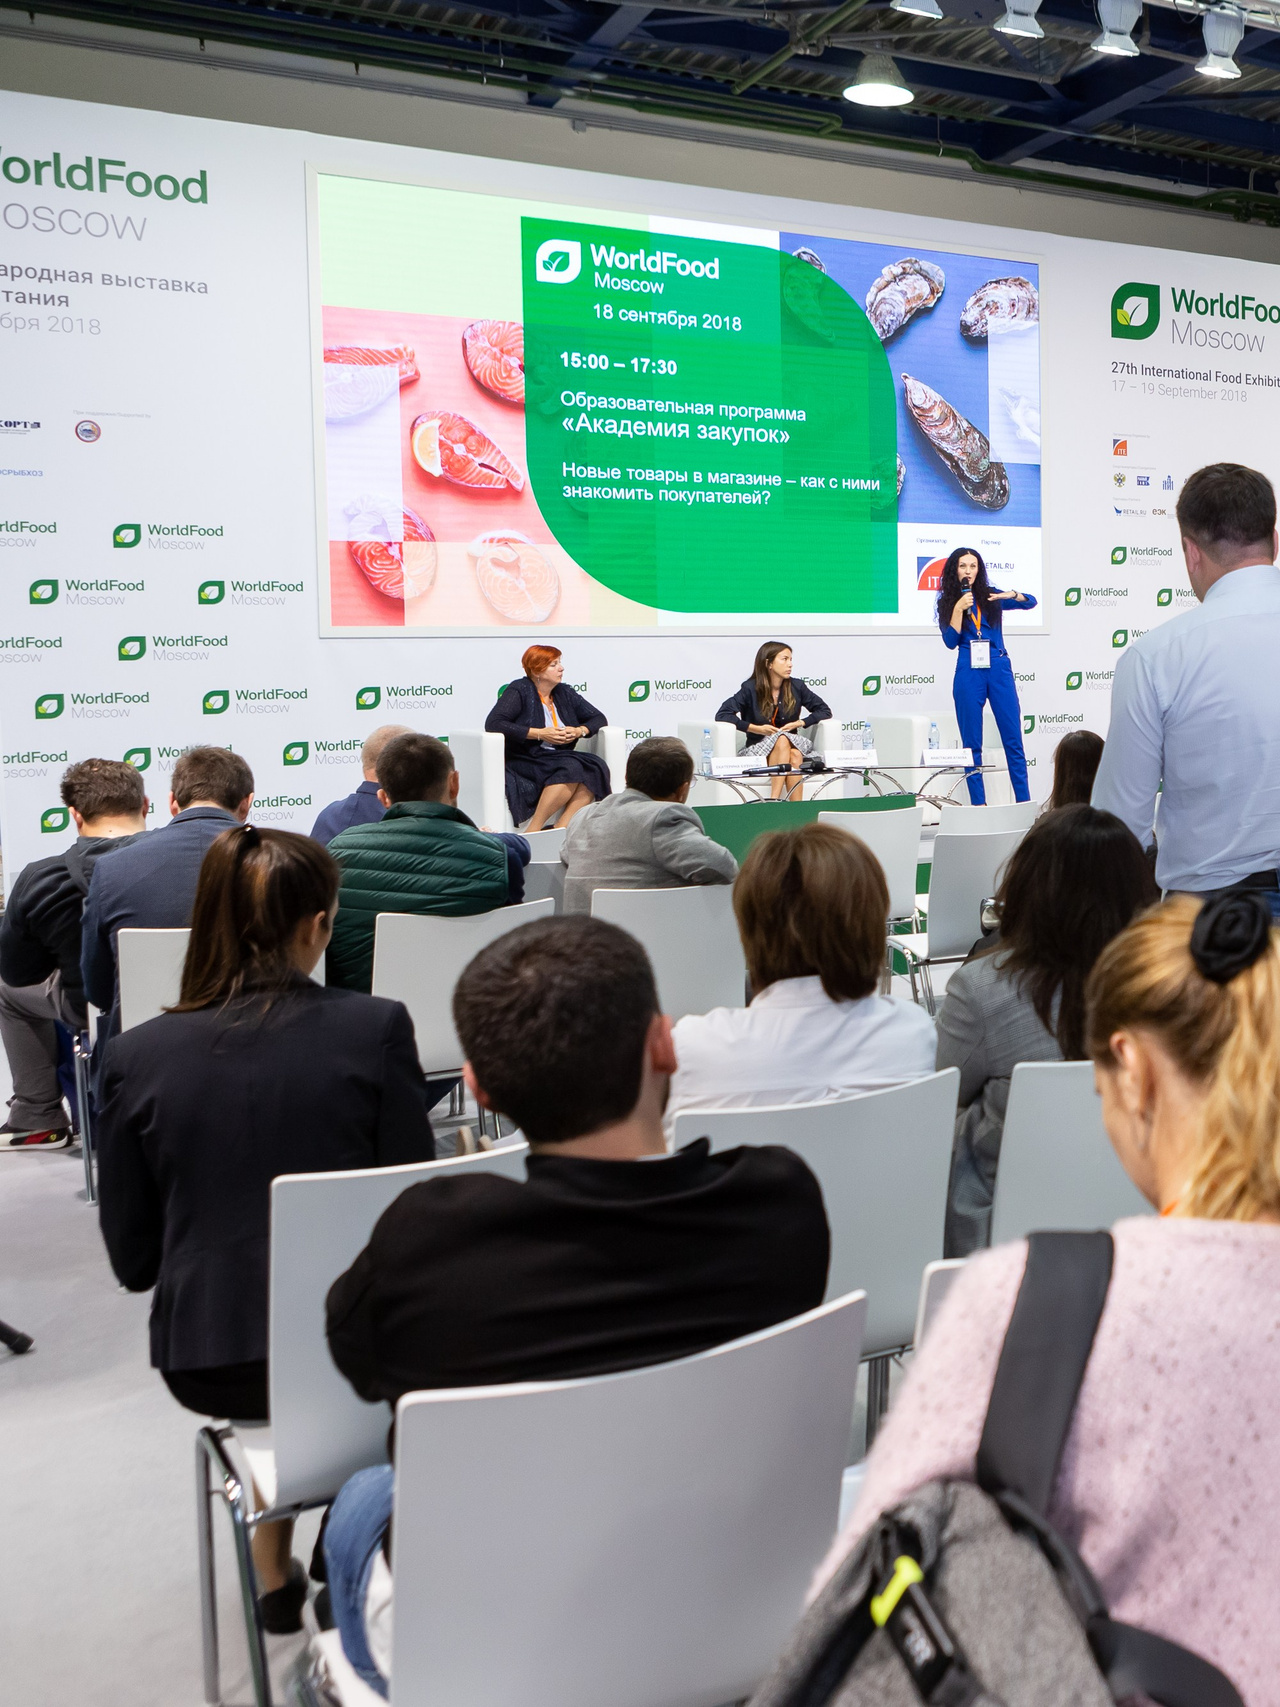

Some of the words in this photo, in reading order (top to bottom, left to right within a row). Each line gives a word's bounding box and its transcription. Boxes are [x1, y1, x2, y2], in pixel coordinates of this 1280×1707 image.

[0, 147, 208, 205] orldFood
[2, 202, 147, 241] oscow
[589, 243, 719, 280] WorldFood
[0, 264, 93, 284] ародная
[101, 273, 209, 295] выставка
[594, 272, 664, 295] Moscow
[1, 290, 70, 308] тания
[0, 311, 40, 334] бря
[47, 315, 102, 336] 2018
[593, 304, 614, 320] 18
[618, 308, 698, 330] сентября
[702, 313, 743, 332] 2018
[1171, 319, 1266, 353] Moscow
[560, 351, 610, 371] 15:00
[630, 357, 678, 376] 17:30
[1111, 361, 1138, 375] 27th
[1141, 364, 1212, 383] International
[1215, 371, 1242, 385] Food
[1112, 379, 1126, 392] 17
[1141, 382, 1155, 395] 19
[1158, 384, 1218, 401] September
[1220, 389, 1248, 403] 2018
[560, 390, 714, 416] Образовательная
[719, 404, 807, 423] программа
[561, 412, 690, 438] «Академия
[697, 424, 790, 446] закупок»
[0, 469, 44, 477] СРЫБХОЗ
[562, 462, 622, 480] Новые
[626, 467, 689, 485] товары
[694, 471, 703, 484] в
[707, 472, 782, 487] магазине
[800, 476, 826, 489] как
[829, 477, 839, 489] с
[842, 477, 881, 491] ними
[562, 485, 654, 501] знакомить
[658, 488, 771, 506] покупателей?
[0, 520, 57, 533] rldFood
[148, 524, 224, 537] WorldFood
[0, 537, 37, 547] scow
[148, 538, 205, 550] Moscow
[1130, 547, 1172, 556] WorldFood
[984, 562, 1015, 570] ETAIL.RU
[65, 579, 145, 592] WorldFood
[231, 580, 304, 593] WorldFood
[928, 576, 943, 588] IT
[1084, 588, 1128, 597] WorldFood
[65, 593, 125, 606] Moscow
[231, 594, 286, 606] Moscow
[0, 636, 62, 649] orldFood
[152, 635, 228, 648] WorldFood
[152, 649, 210, 661] Moscow
[885, 674, 935, 685] WorldFood
[1085, 670, 1114, 680] WorldF
[386, 685, 453, 697] WorldFood
[654, 679, 712, 690] WorldFood
[1085, 682, 1112, 690] Mosco
[71, 692, 150, 705] WorldFood
[235, 688, 308, 701] WorldFood
[654, 691, 698, 702] Moscow
[235, 702, 290, 714] Moscow
[386, 699, 437, 710] Moscow
[71, 706, 131, 719] Moscow
[1038, 713, 1084, 723] WorldFood
[2, 750, 68, 764] orldFood
[3, 768, 48, 778] oscow
[251, 794, 312, 809] orldFood
[250, 811, 294, 822] oscow
